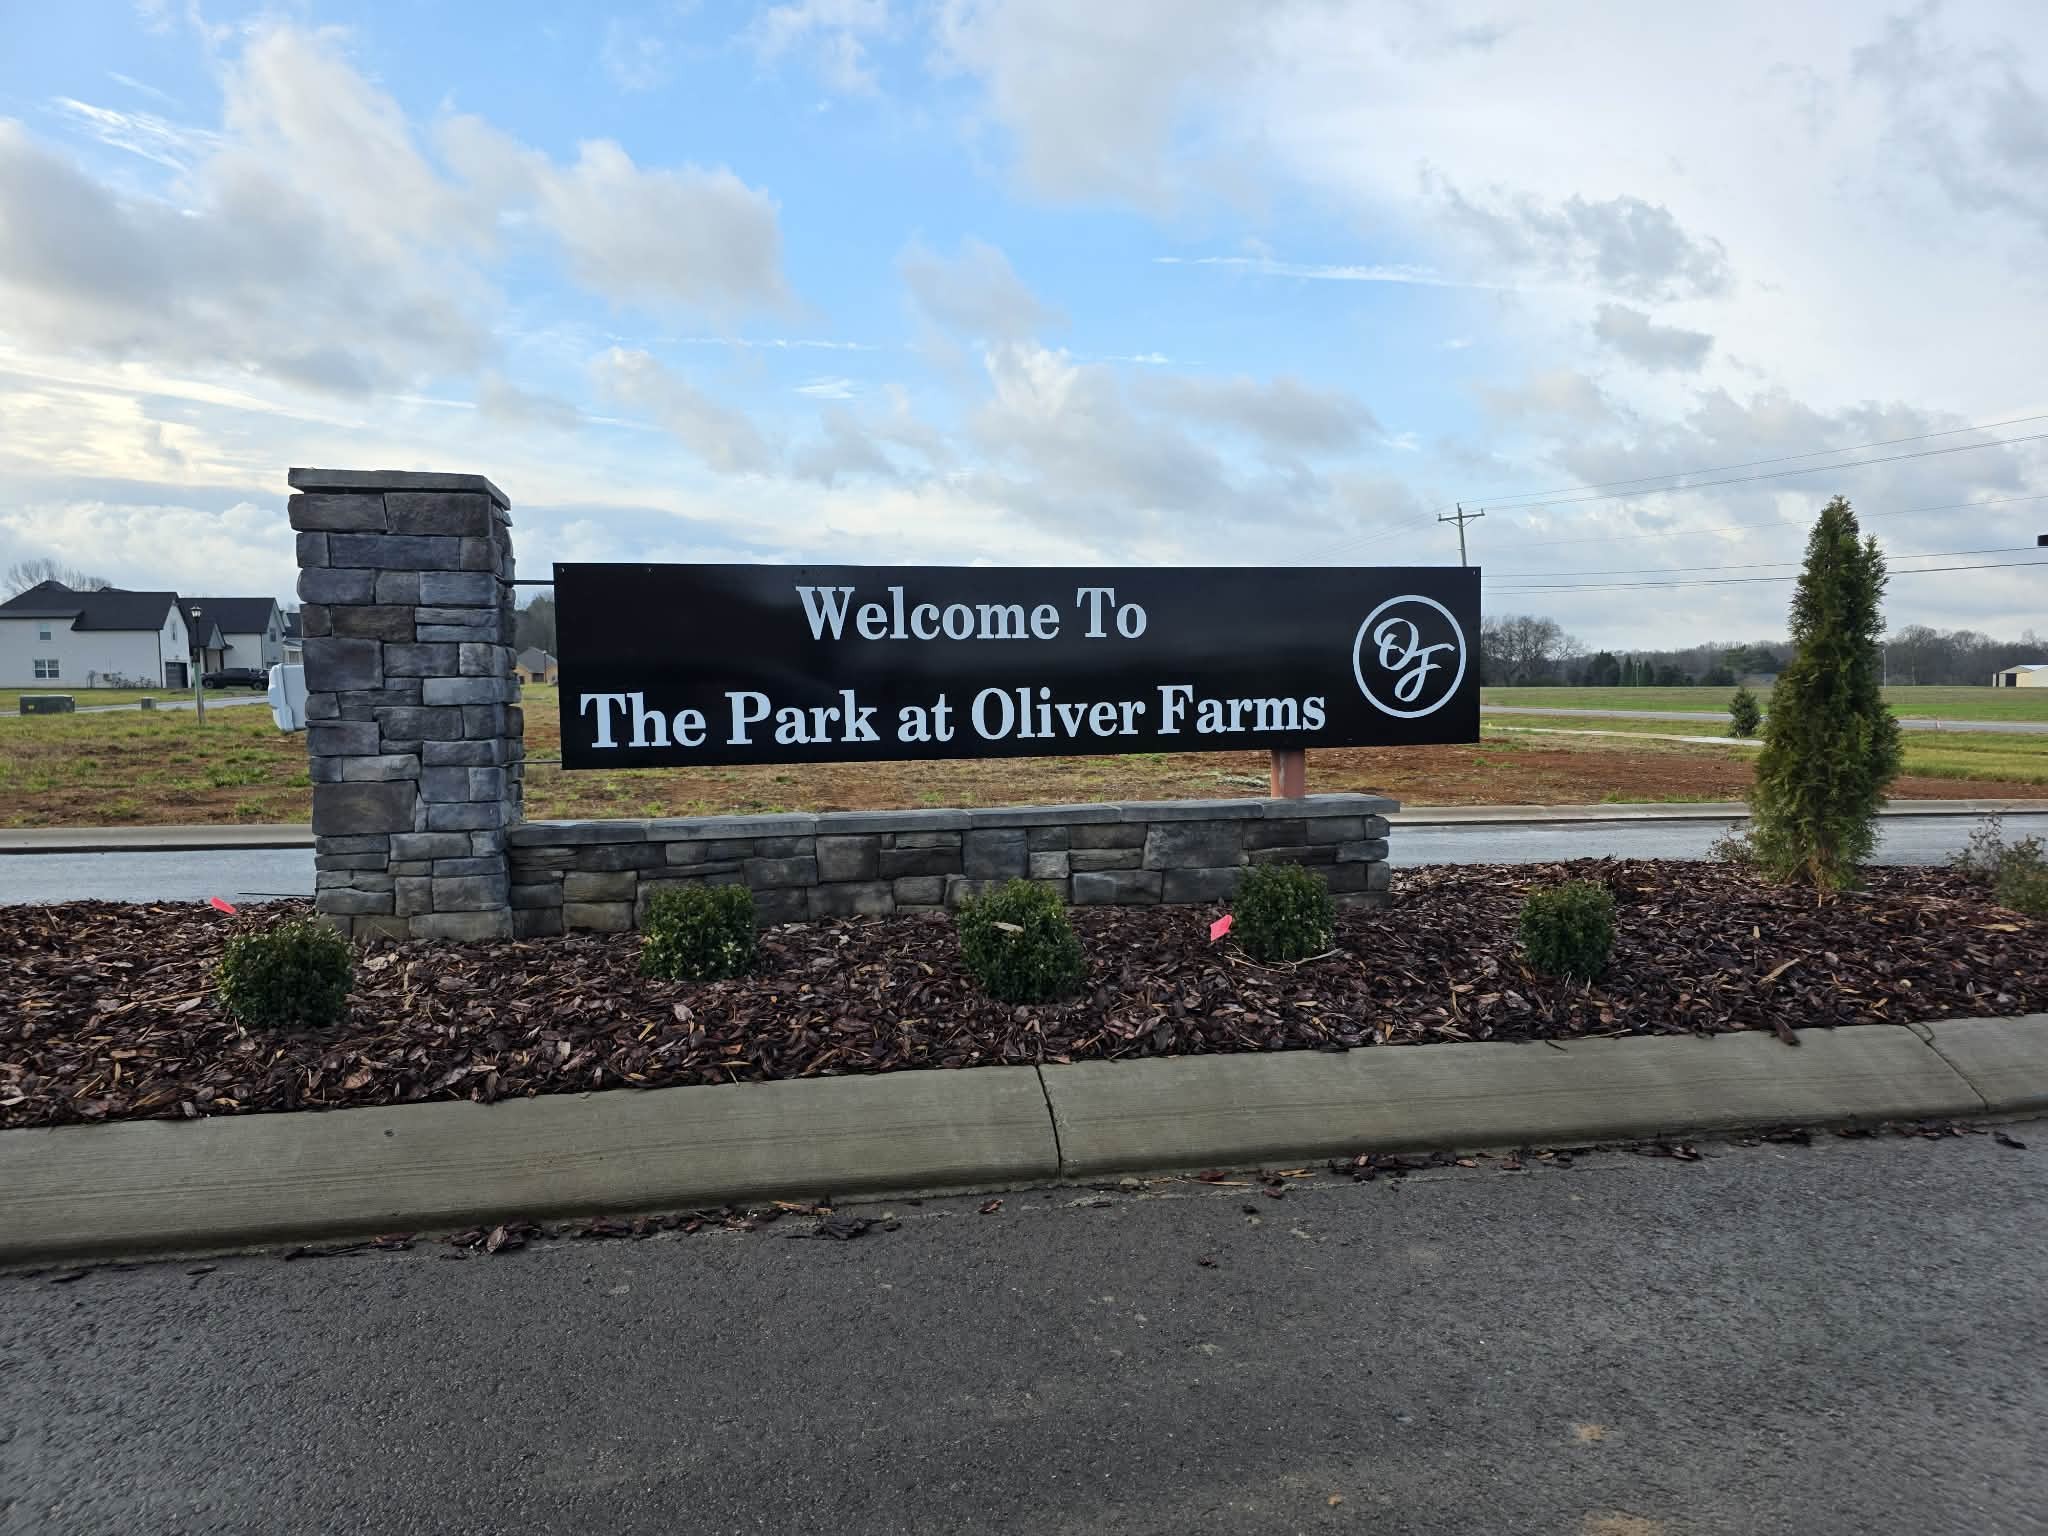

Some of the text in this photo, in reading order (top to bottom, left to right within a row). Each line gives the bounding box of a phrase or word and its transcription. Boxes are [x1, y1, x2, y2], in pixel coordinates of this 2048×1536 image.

[796, 585, 1147, 641] Welcome To
[580, 684, 1327, 749] The Park at Oliver Farms
